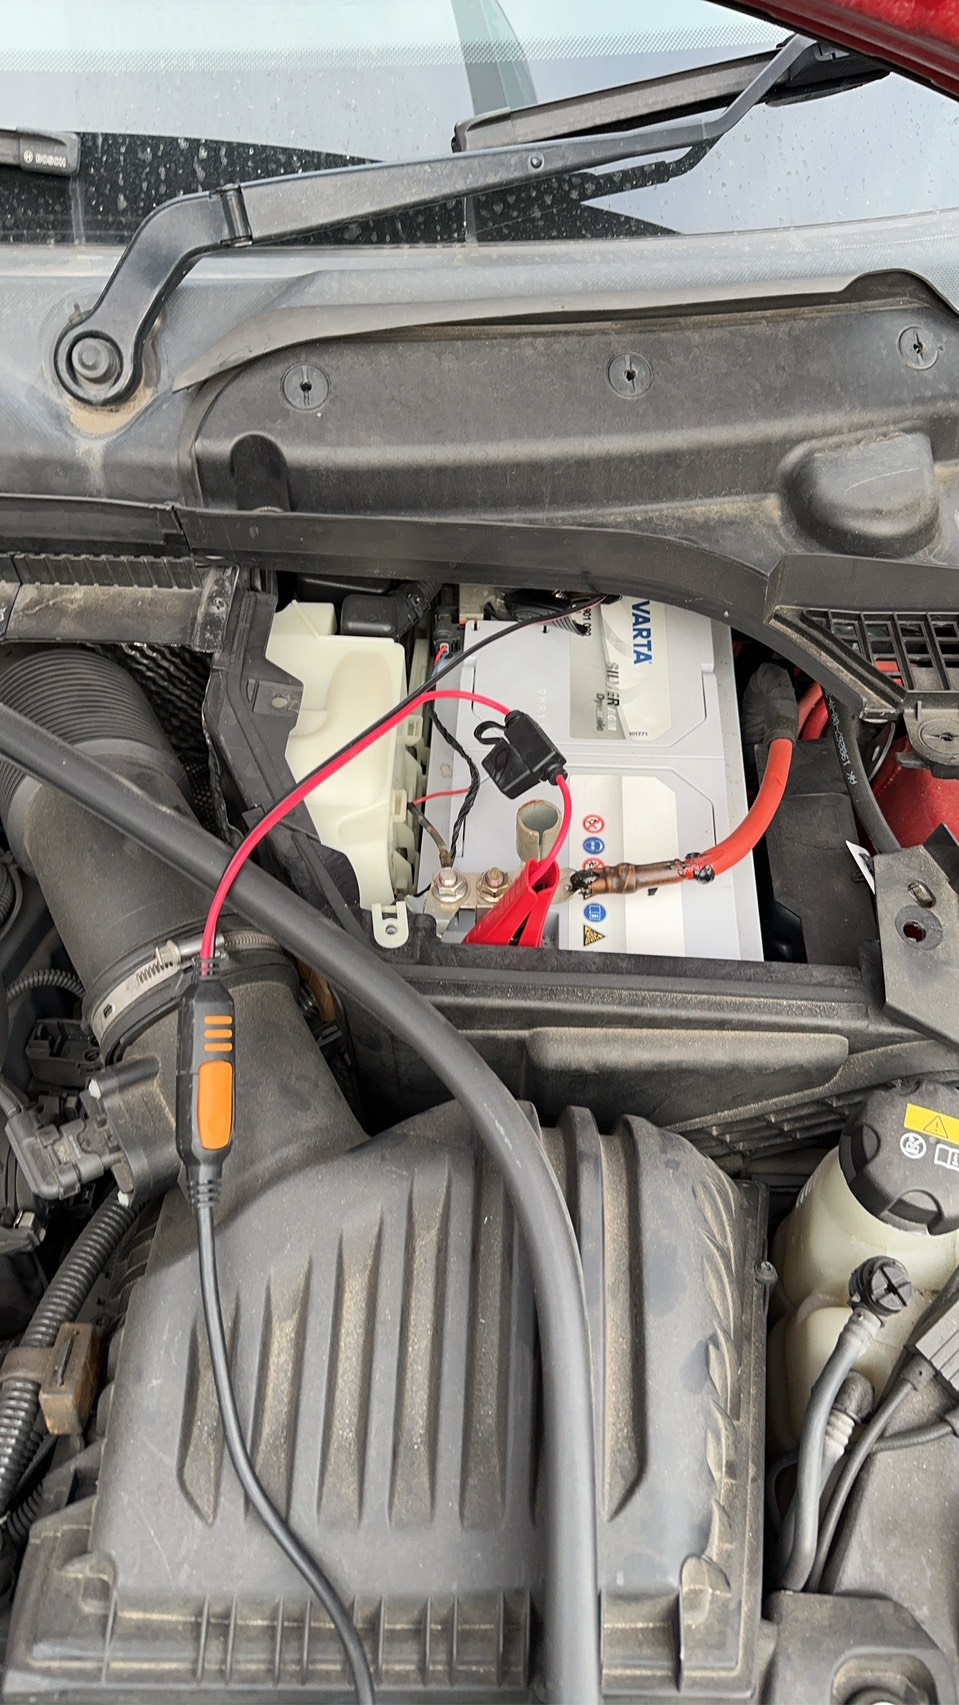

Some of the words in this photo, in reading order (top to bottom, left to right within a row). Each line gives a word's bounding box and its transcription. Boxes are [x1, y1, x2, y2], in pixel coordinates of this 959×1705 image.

[35, 152, 67, 168] BOSCH
[632, 600, 652, 664] VARTA
[606, 662, 620, 706] SILVER
